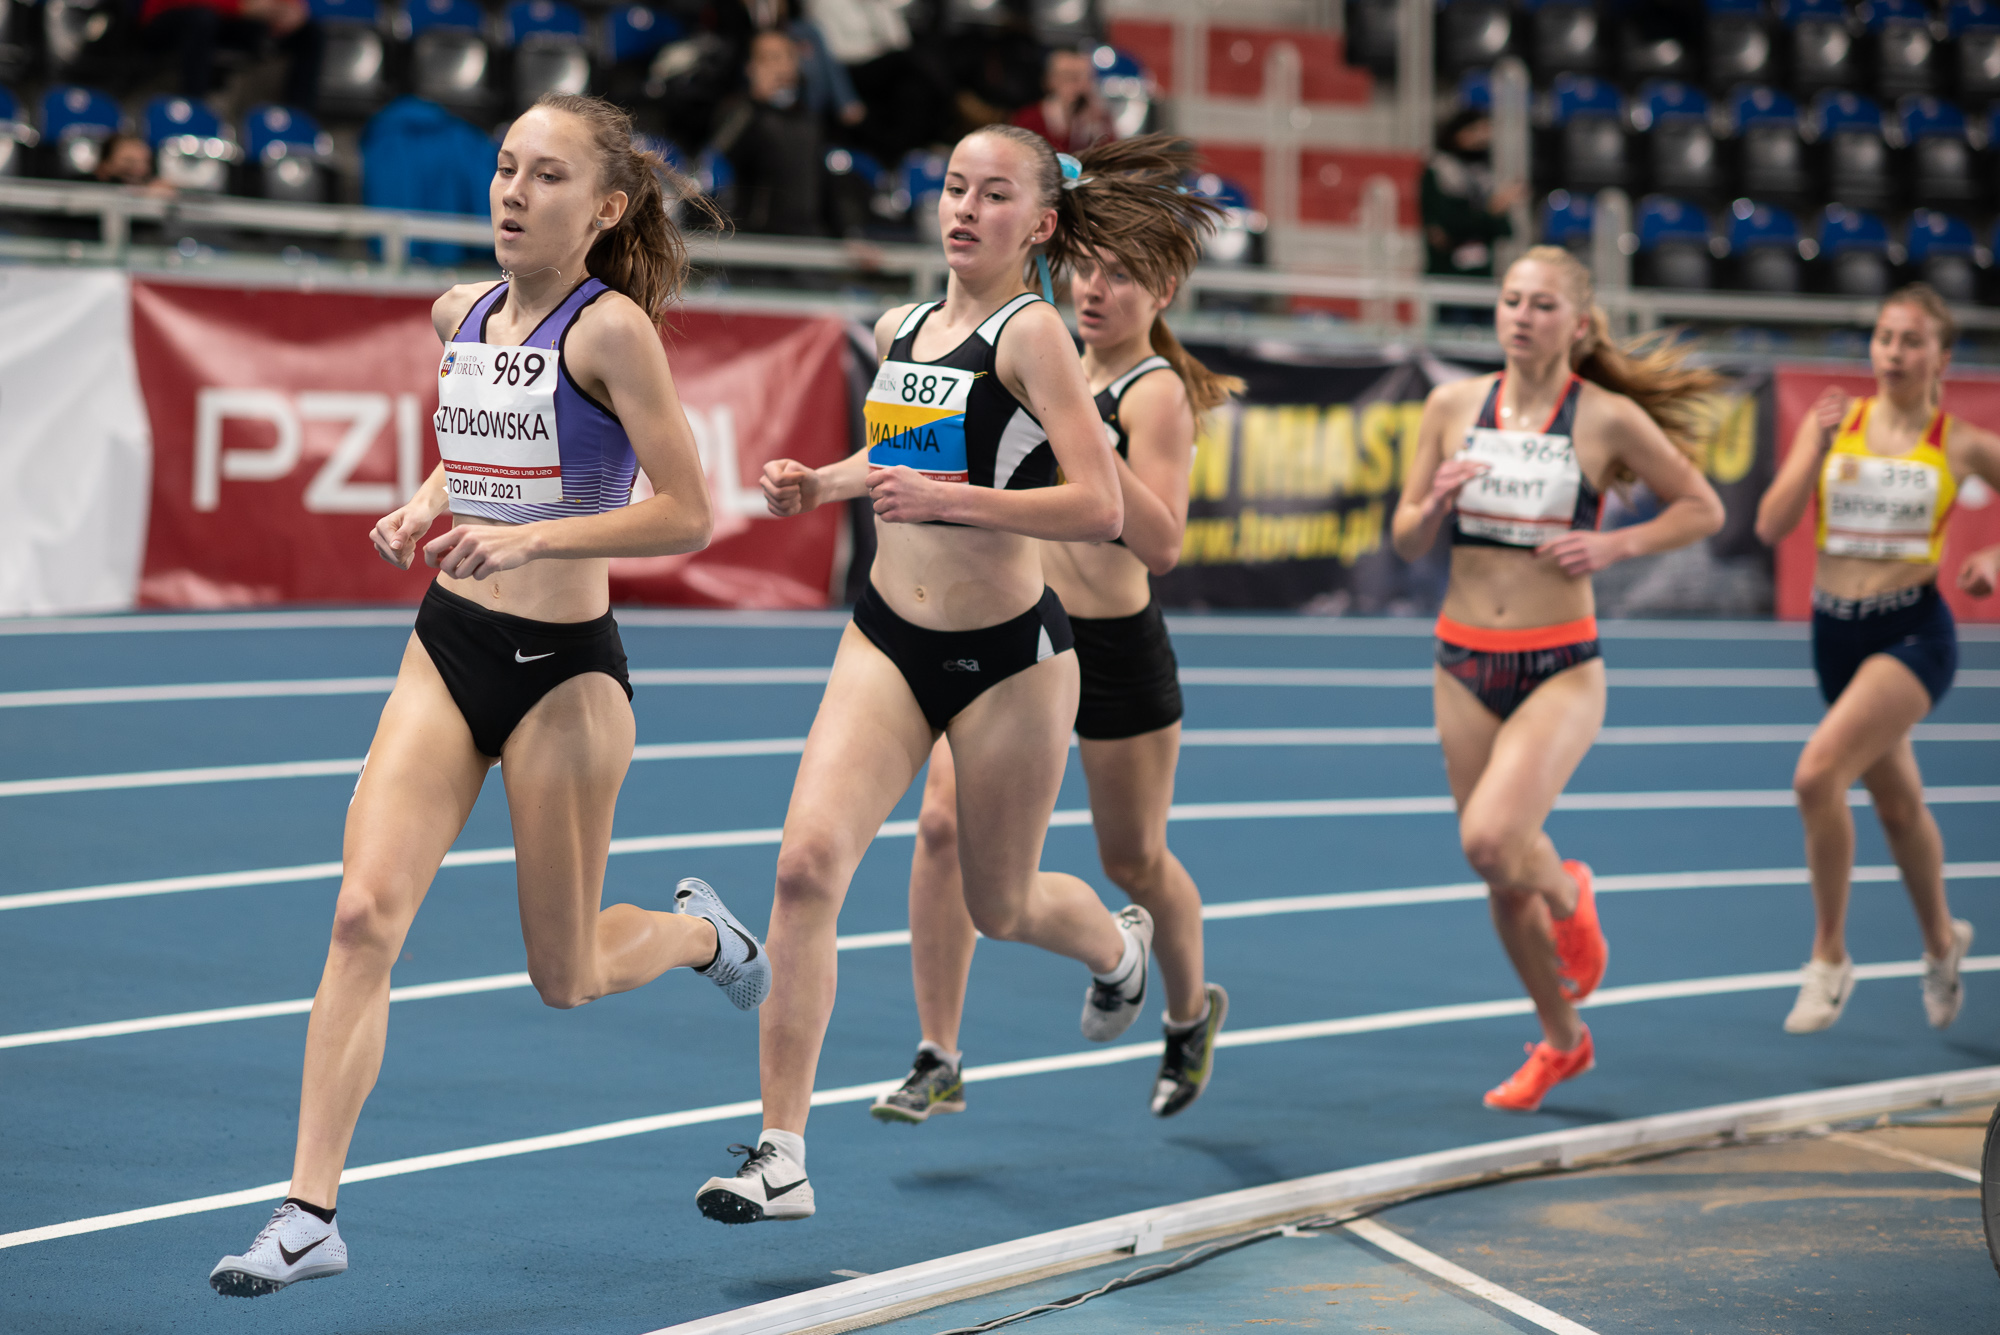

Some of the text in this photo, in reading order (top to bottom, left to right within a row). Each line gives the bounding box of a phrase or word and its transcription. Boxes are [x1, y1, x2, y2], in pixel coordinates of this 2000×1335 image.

[492, 351, 546, 387] 969
[901, 373, 960, 406] 887
[436, 405, 549, 440] SZYDŁOWSKA
[870, 421, 941, 453] MALINA
[448, 476, 522, 499] TORUŃ 2021
[499, 468, 520, 476] POLSKI
[1481, 477, 1546, 498] PERYT
